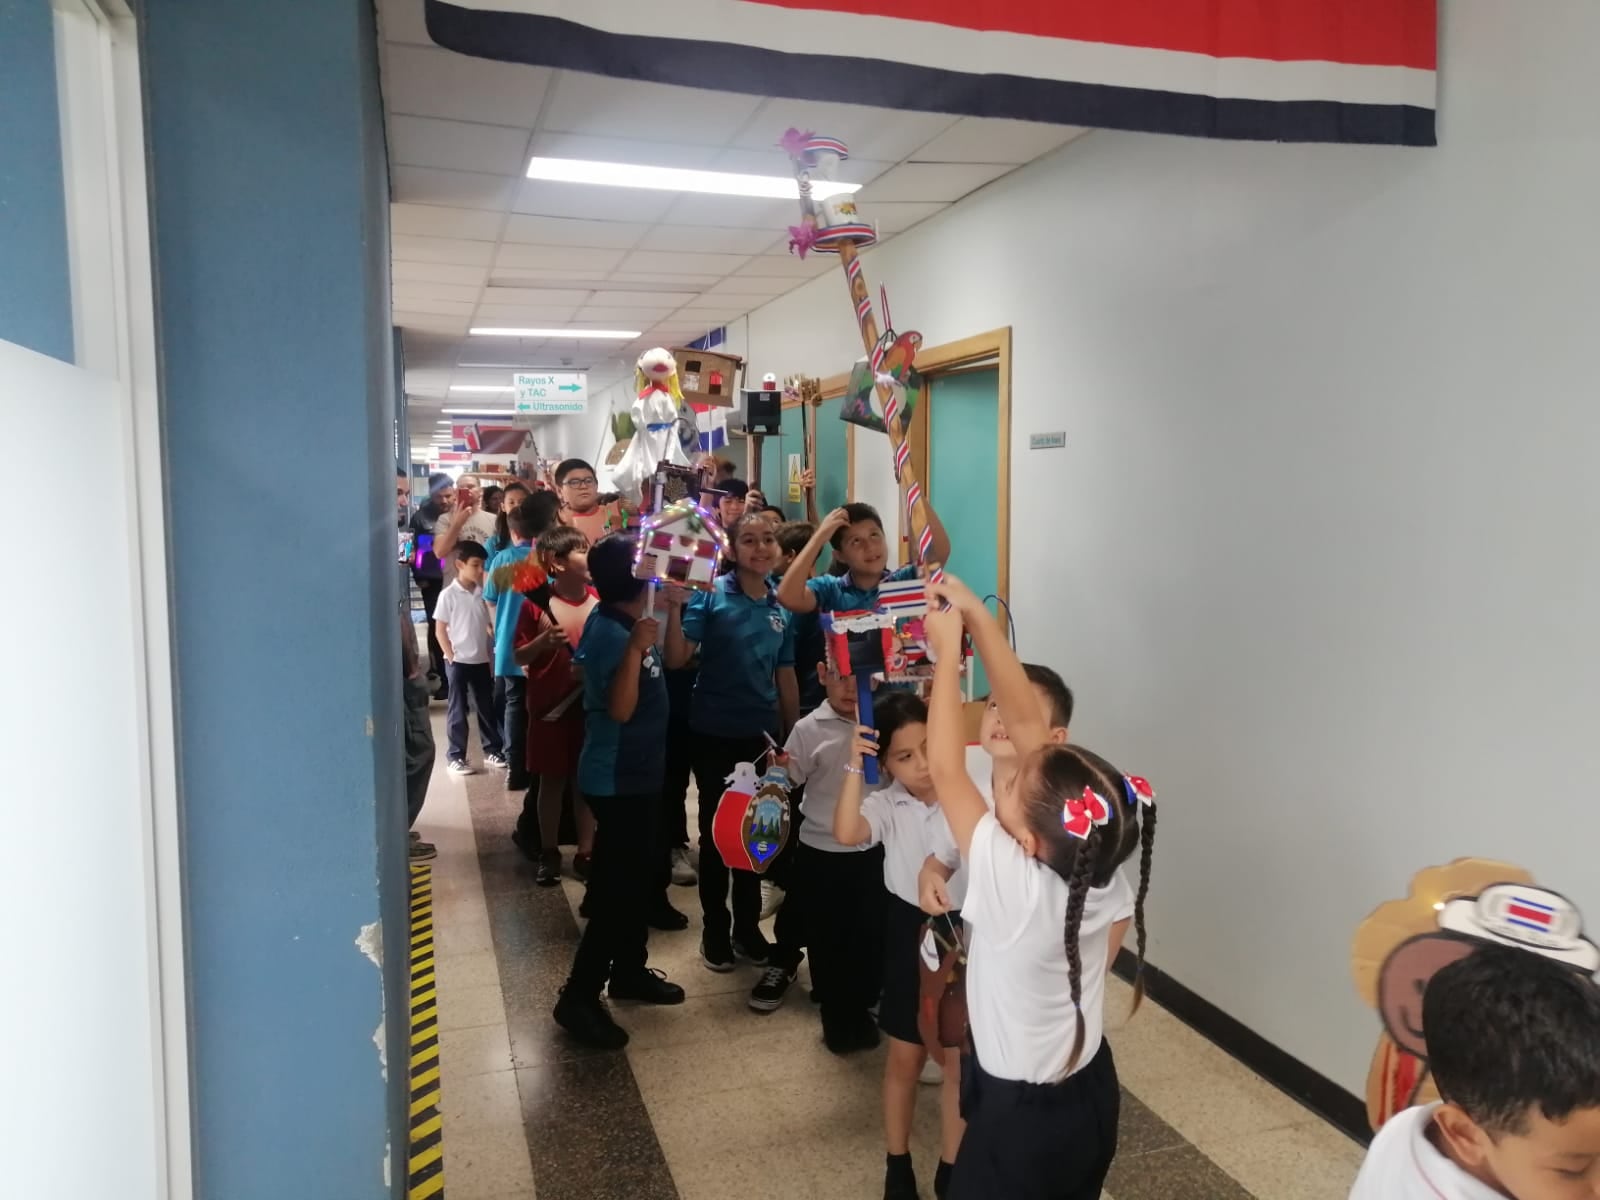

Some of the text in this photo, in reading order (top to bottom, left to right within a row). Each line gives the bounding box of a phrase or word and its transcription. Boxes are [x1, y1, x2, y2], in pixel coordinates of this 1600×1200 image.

[518, 375, 555, 386] Rayos X
[520, 388, 546, 398] y TAC
[532, 402, 583, 411] Ultrasonido
